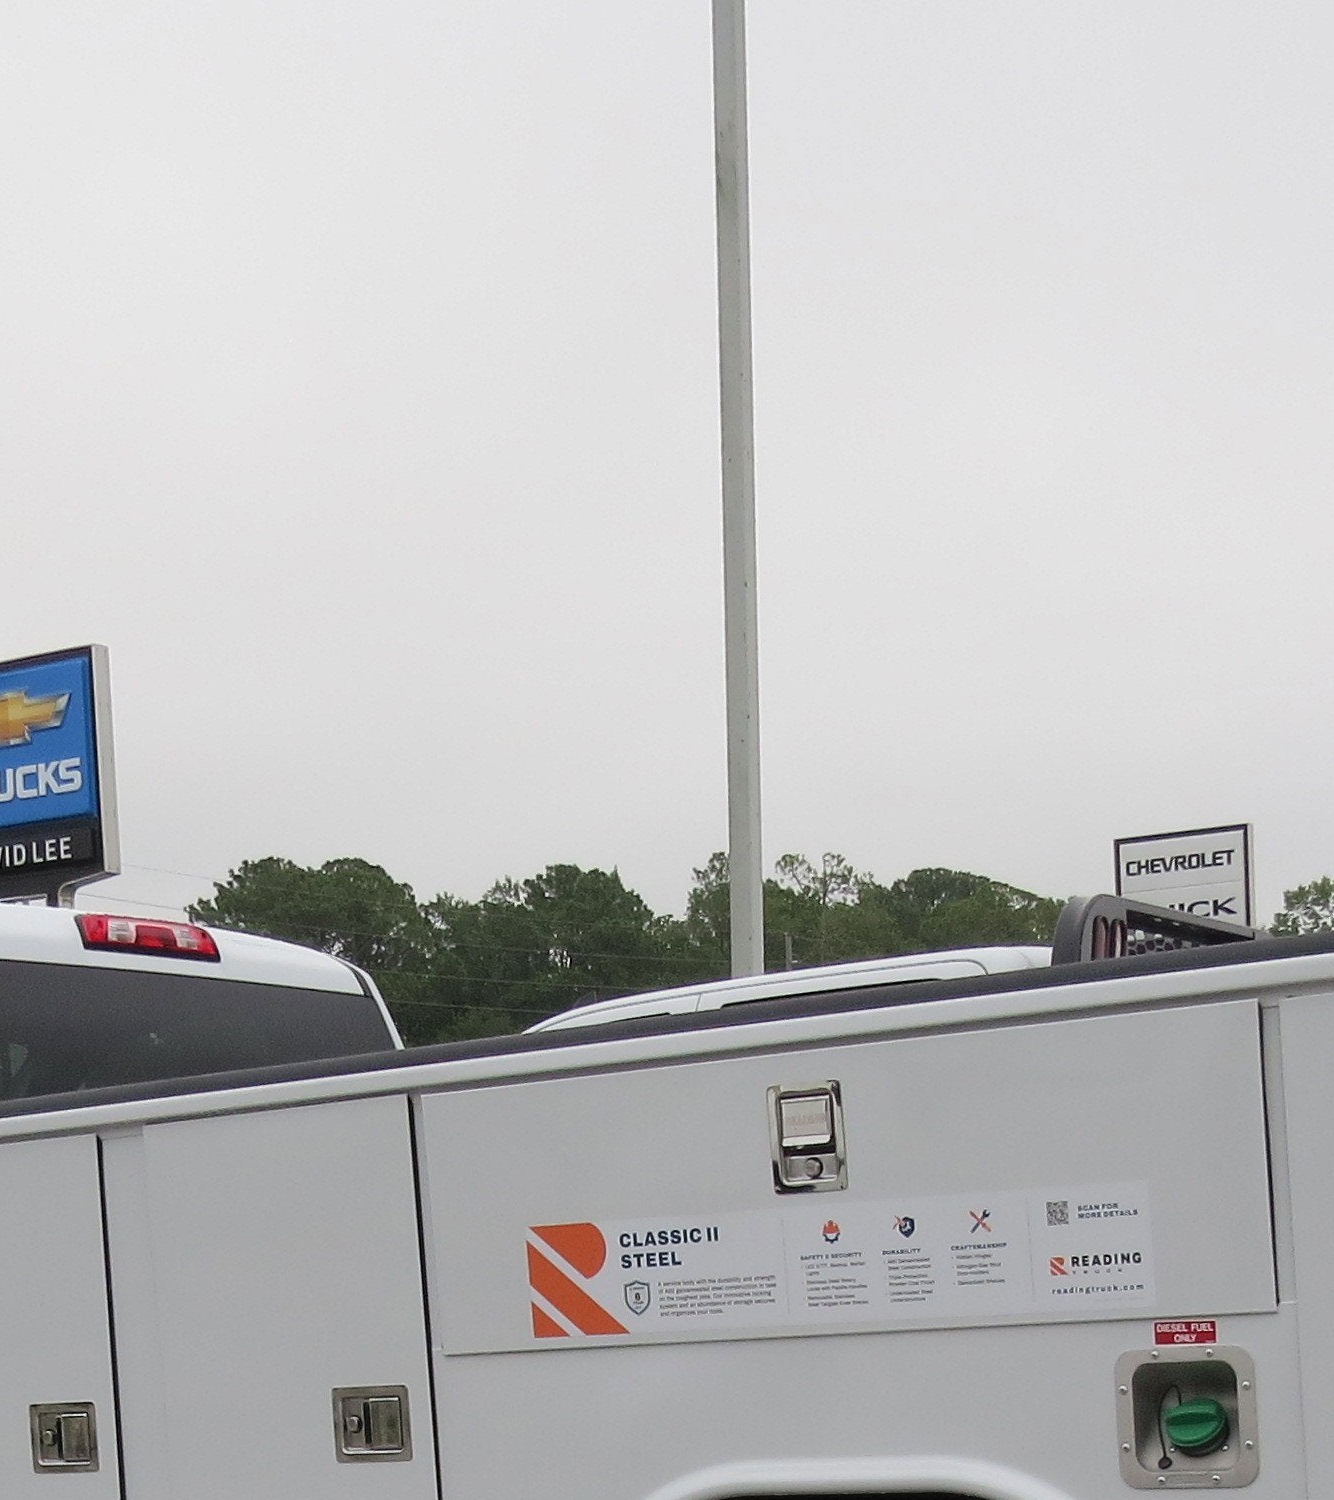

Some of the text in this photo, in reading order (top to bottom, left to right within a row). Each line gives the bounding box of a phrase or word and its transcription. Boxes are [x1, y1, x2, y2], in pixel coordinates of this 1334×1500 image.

[32, 836, 73, 863] LEE
[1125, 849, 1235, 876] CHEVROLET
[1168, 897, 1237, 917] ICK
[1078, 1202, 1118, 1212] SCAN FOR
[1103, 1209, 1138, 1217] DETAILS
[619, 1226, 719, 1247] CLASSIC II
[621, 1252, 682, 1269] STEEL
[1071, 1252, 1142, 1267] READING
[1052, 1284, 1145, 1295] readingtruck.com
[1156, 1323, 1214, 1333] DIESEL FUEL
[1173, 1334, 1197, 1343] ONLY
